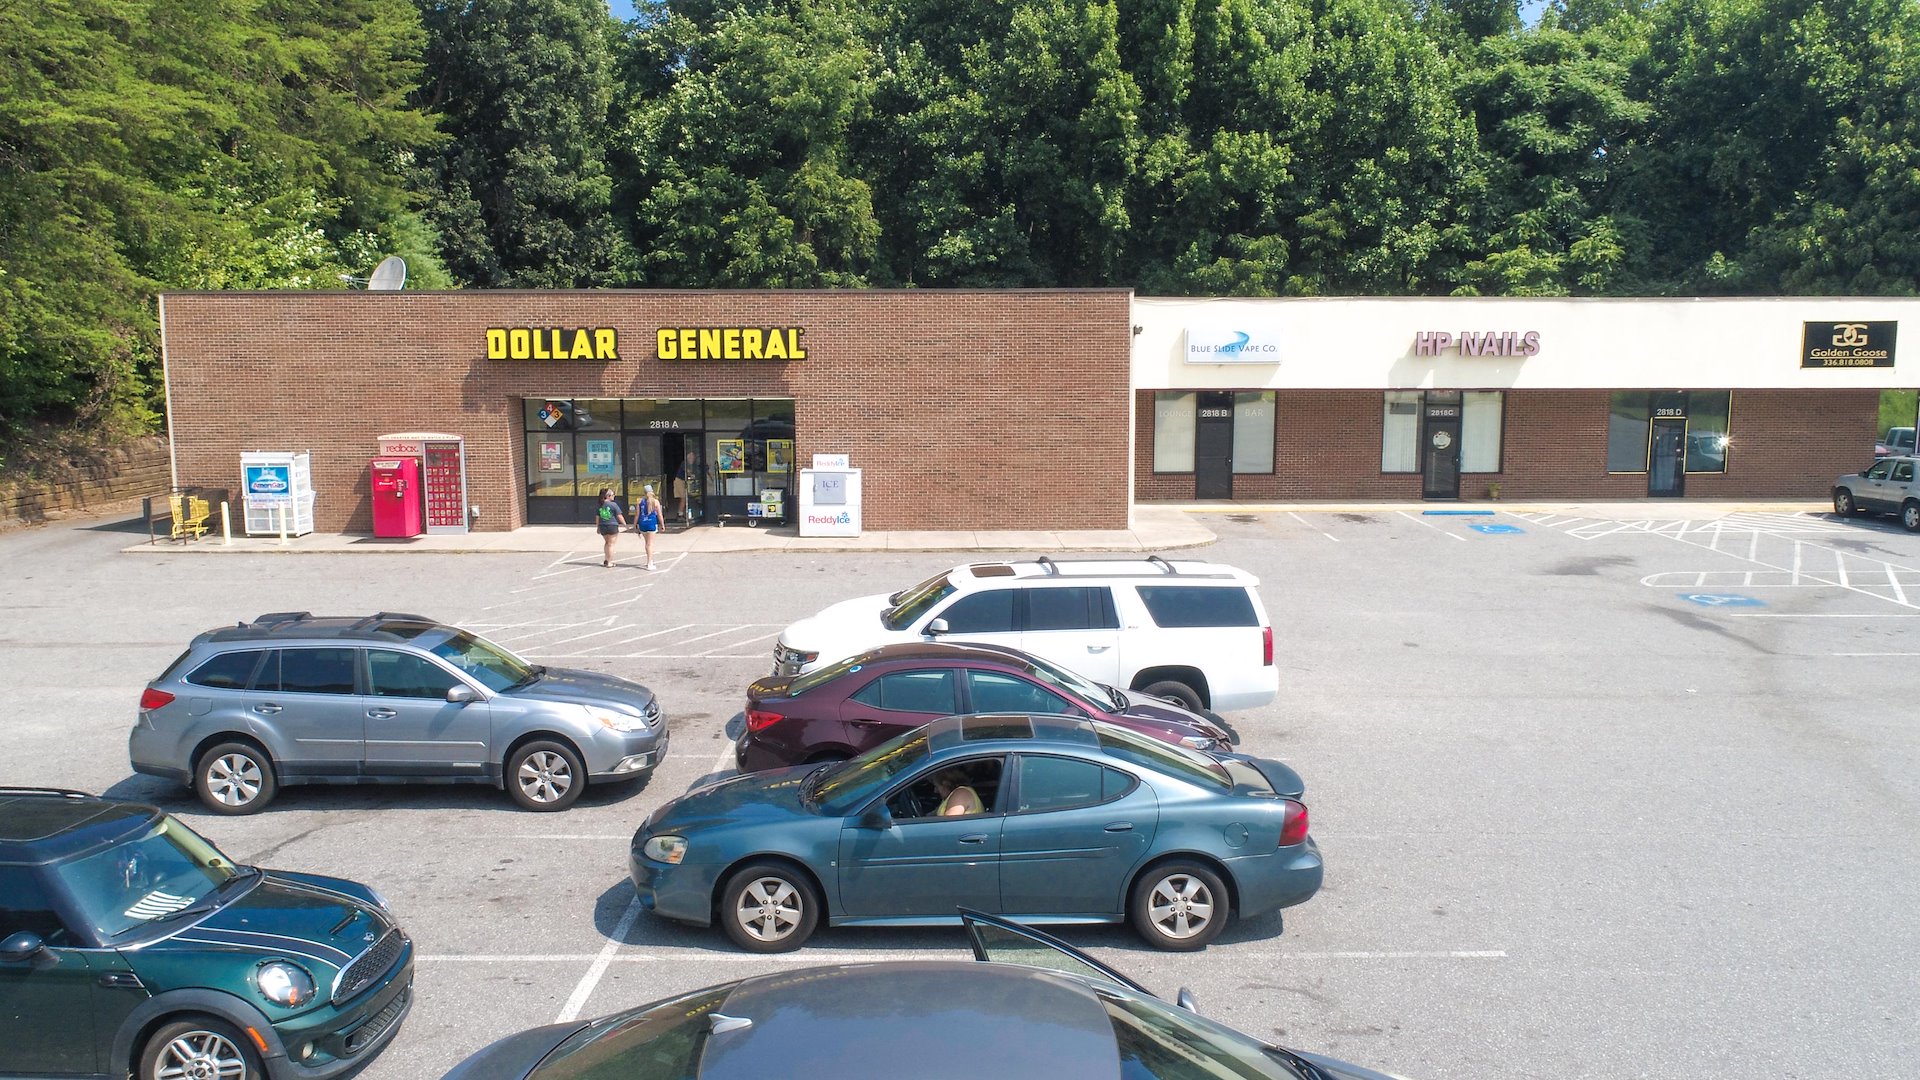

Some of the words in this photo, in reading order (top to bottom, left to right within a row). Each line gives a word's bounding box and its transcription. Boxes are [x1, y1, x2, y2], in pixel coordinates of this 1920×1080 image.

[486, 328, 618, 361] DOLLAR
[657, 328, 806, 361] GENERAL
[1416, 331, 1452, 357] HP
[1460, 331, 1541, 357] NAILS
[1810, 348, 1850, 357] Golden
[1852, 348, 1888, 357] Goose
[540, 410, 547, 419] 3
[1202, 409, 1220, 417] 2818
[1221, 409, 1228, 417] B
[1245, 409, 1264, 417] BAR
[1656, 408, 1674, 416] 2818
[1675, 408, 1682, 416] D
[650, 421, 670, 429] 2818
[671, 421, 679, 429] A
[822, 480, 839, 488] ICE
